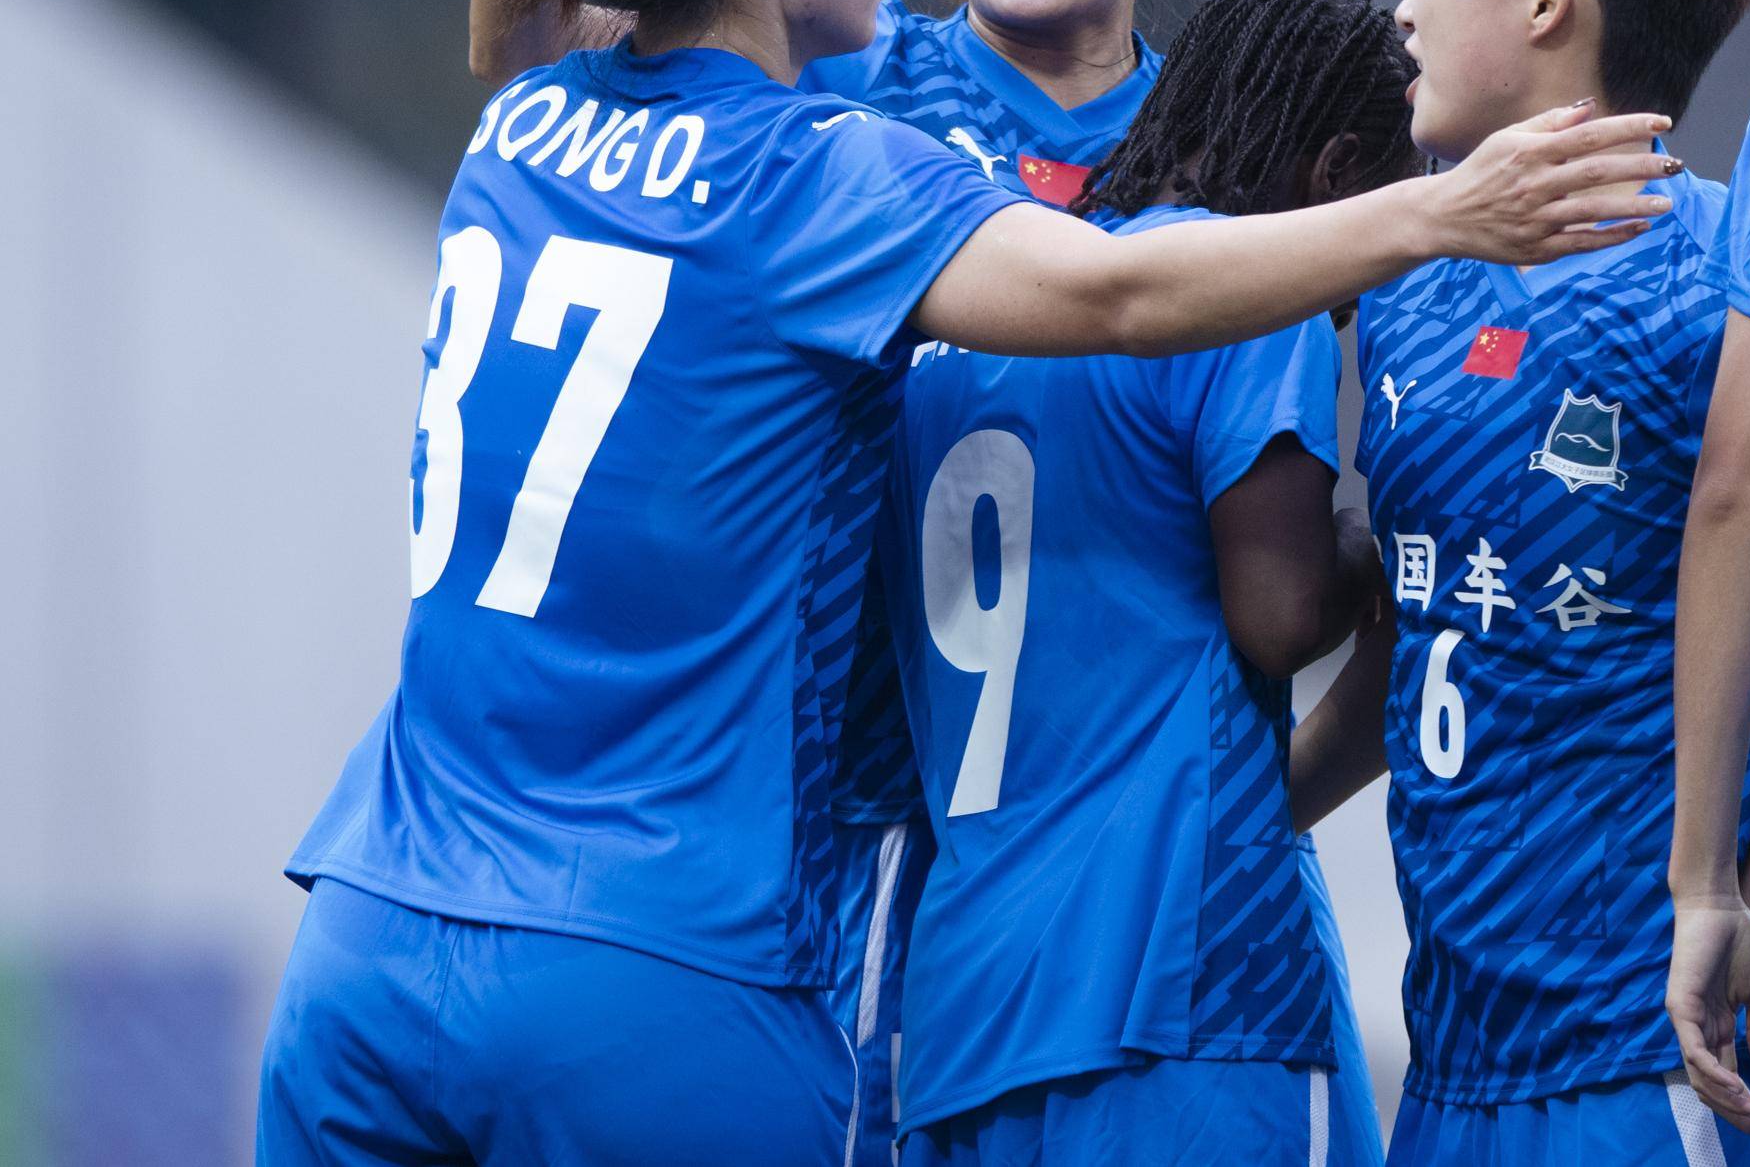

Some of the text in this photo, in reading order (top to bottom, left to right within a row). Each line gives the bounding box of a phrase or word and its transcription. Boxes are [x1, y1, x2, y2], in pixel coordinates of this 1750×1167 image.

[466, 80, 711, 205] SONG D.
[409, 225, 674, 618] 37
[922, 428, 1035, 817] 9
[1373, 532, 1632, 633] 国车谷
[1420, 628, 1469, 779] 6
